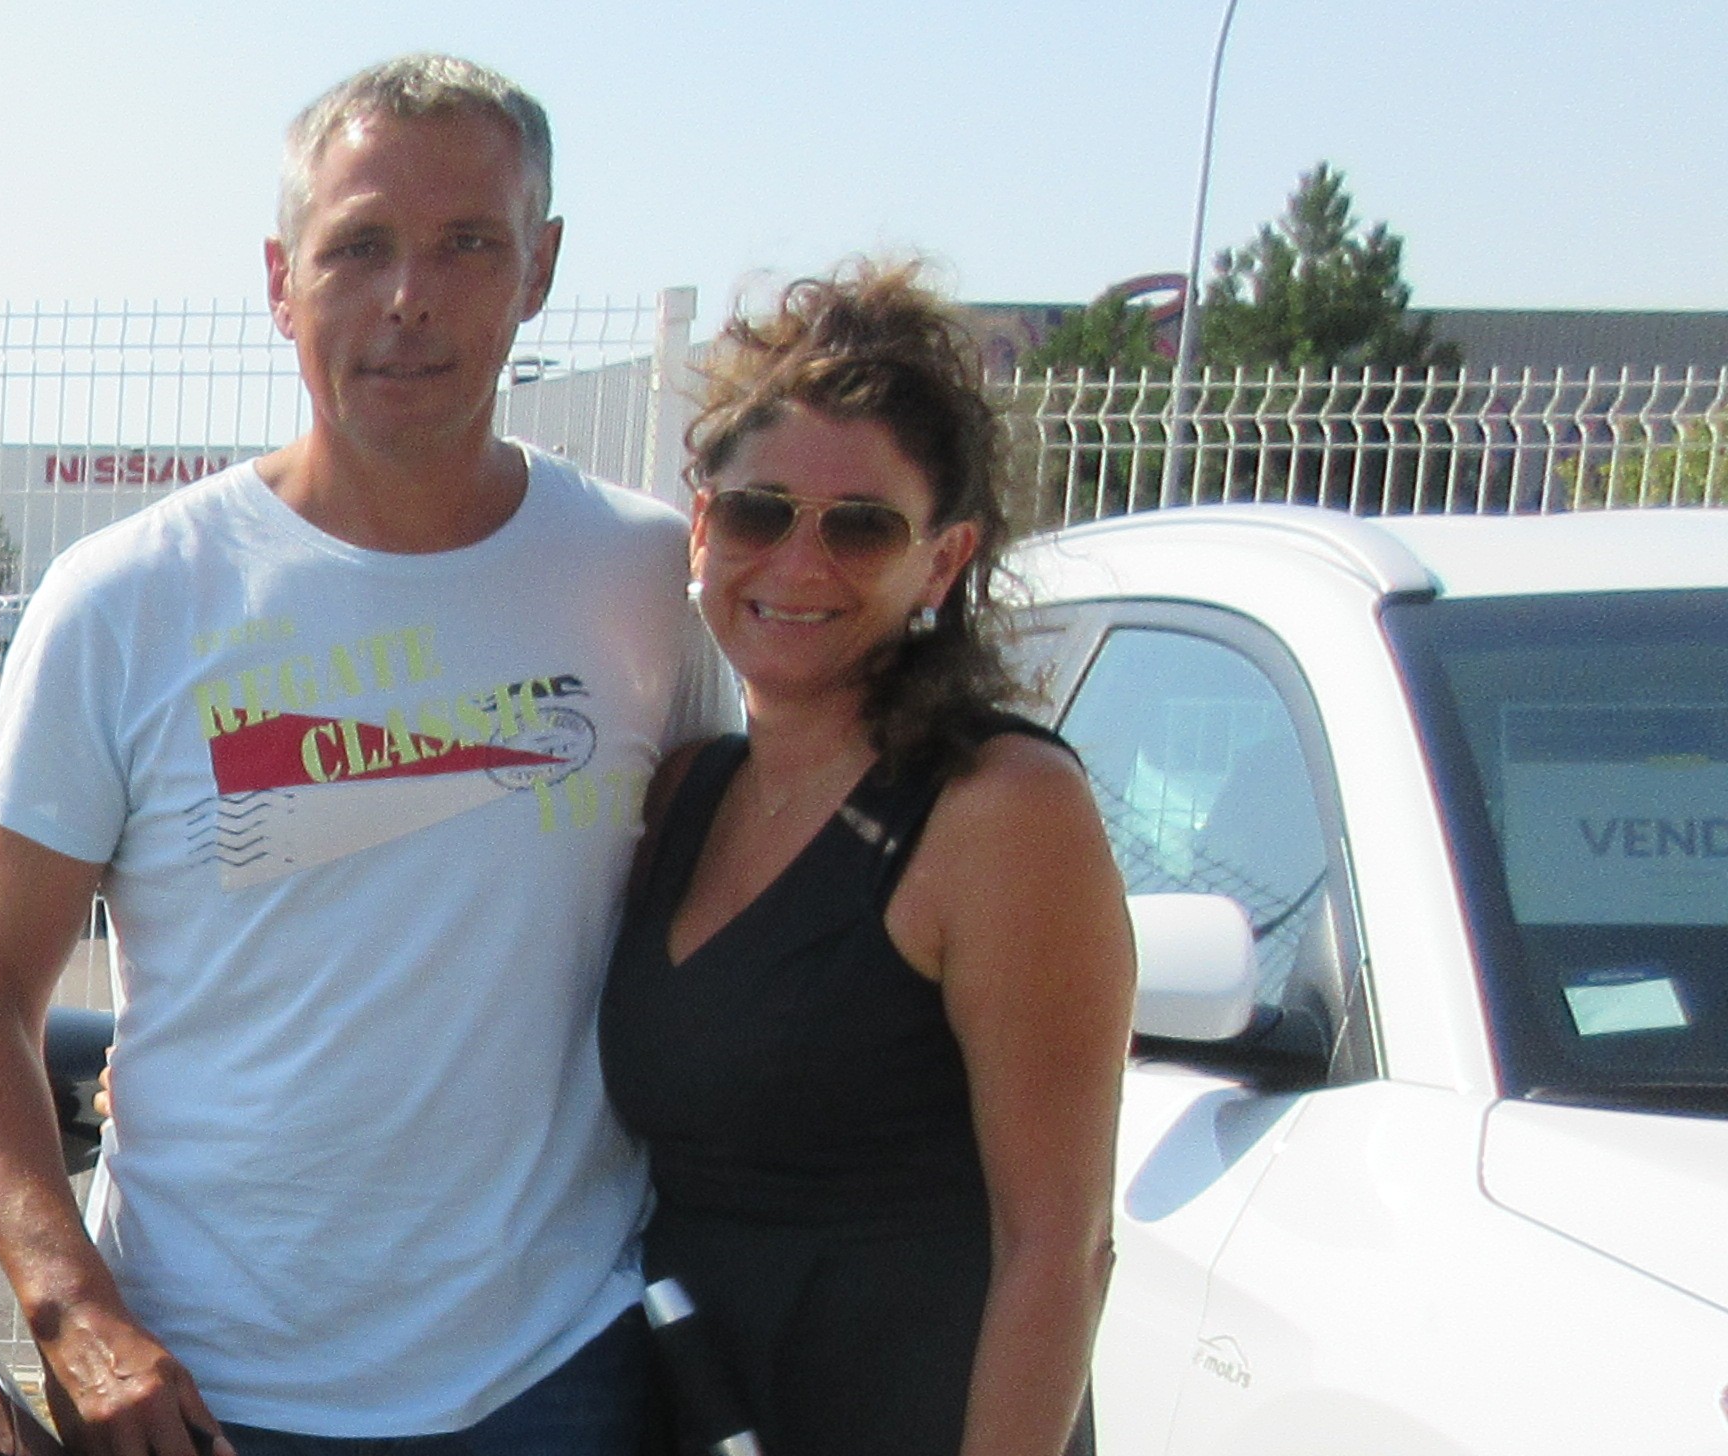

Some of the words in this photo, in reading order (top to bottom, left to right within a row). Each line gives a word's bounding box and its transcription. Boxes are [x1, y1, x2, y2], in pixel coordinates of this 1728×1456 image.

[46, 455, 229, 485] NISSAN
[192, 626, 441, 740] REGATE
[299, 677, 552, 784] CLASSIC
